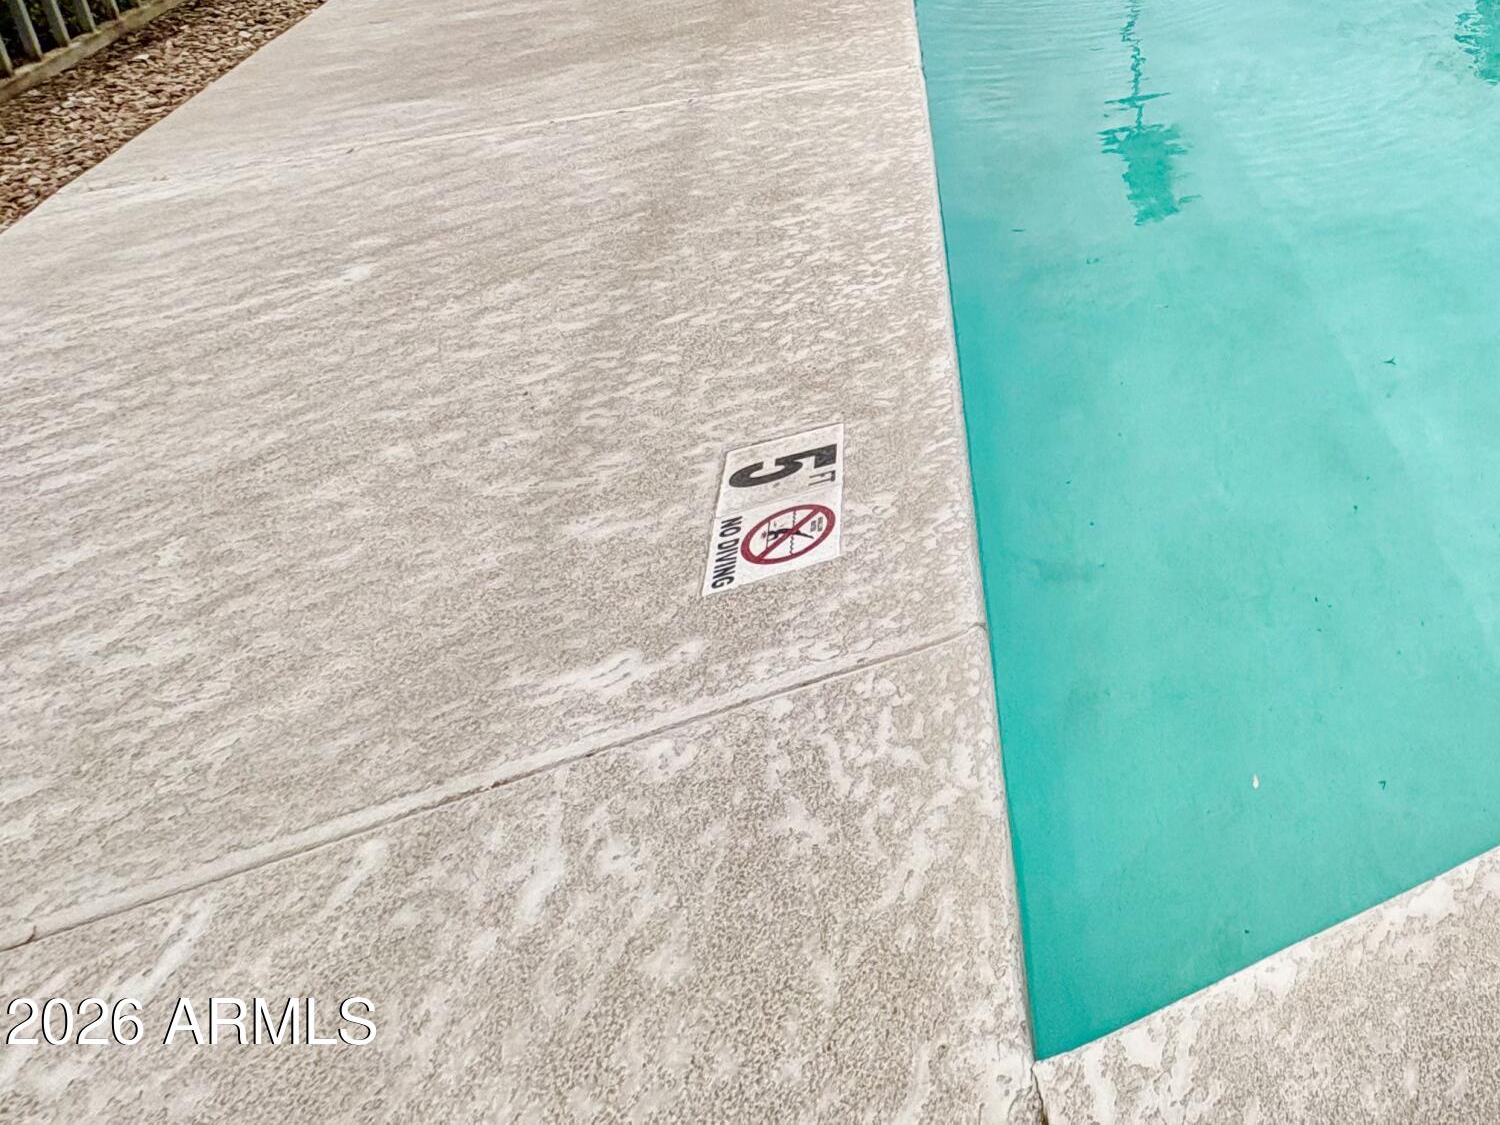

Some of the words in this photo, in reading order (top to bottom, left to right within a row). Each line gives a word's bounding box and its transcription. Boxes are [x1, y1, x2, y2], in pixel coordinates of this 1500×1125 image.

[729, 443, 837, 488] 5
[808, 469, 836, 486] FT
[719, 515, 743, 538] NO
[711, 538, 740, 589] DIVING
